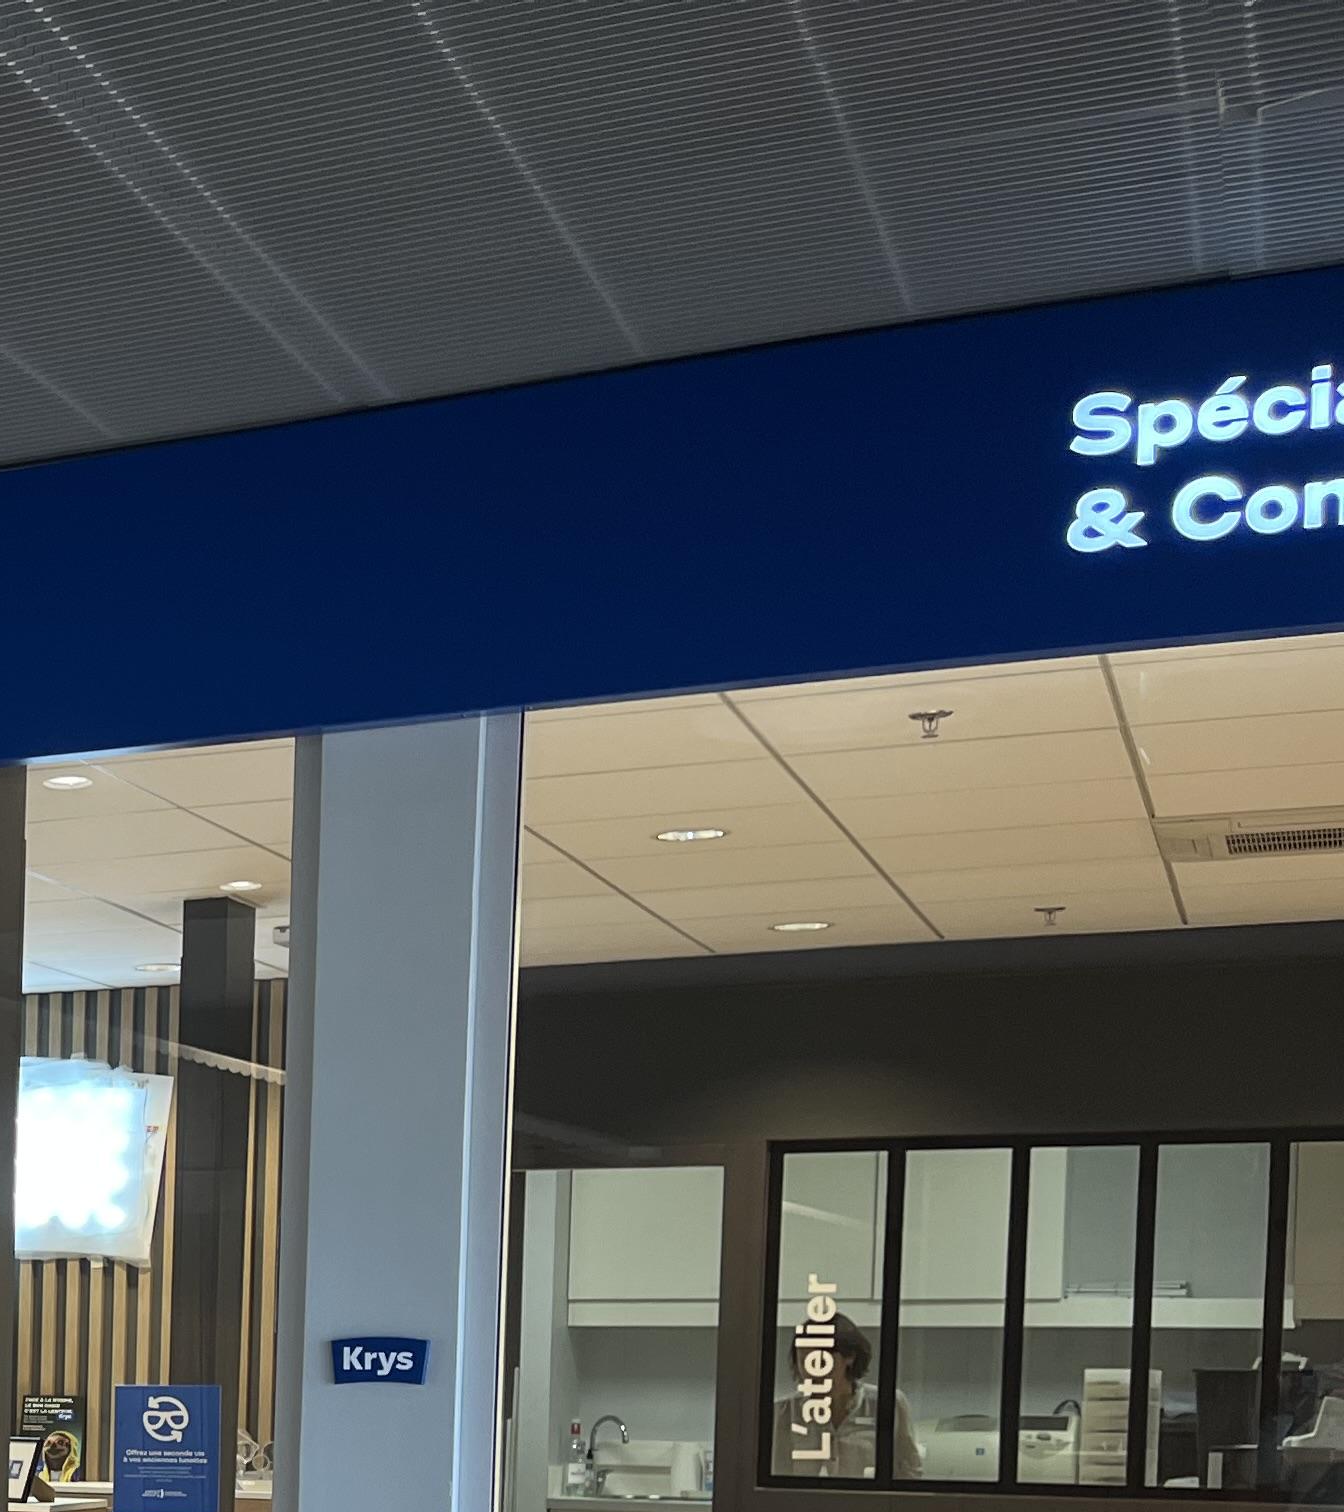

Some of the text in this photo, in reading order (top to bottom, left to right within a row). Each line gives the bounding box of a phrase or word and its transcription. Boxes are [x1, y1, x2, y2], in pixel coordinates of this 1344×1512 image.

[1069, 364, 1344, 466] Spéci
[1066, 488, 1148, 553] &
[342, 1345, 414, 1376] Krys
[791, 1272, 838, 1460] L'atelier
